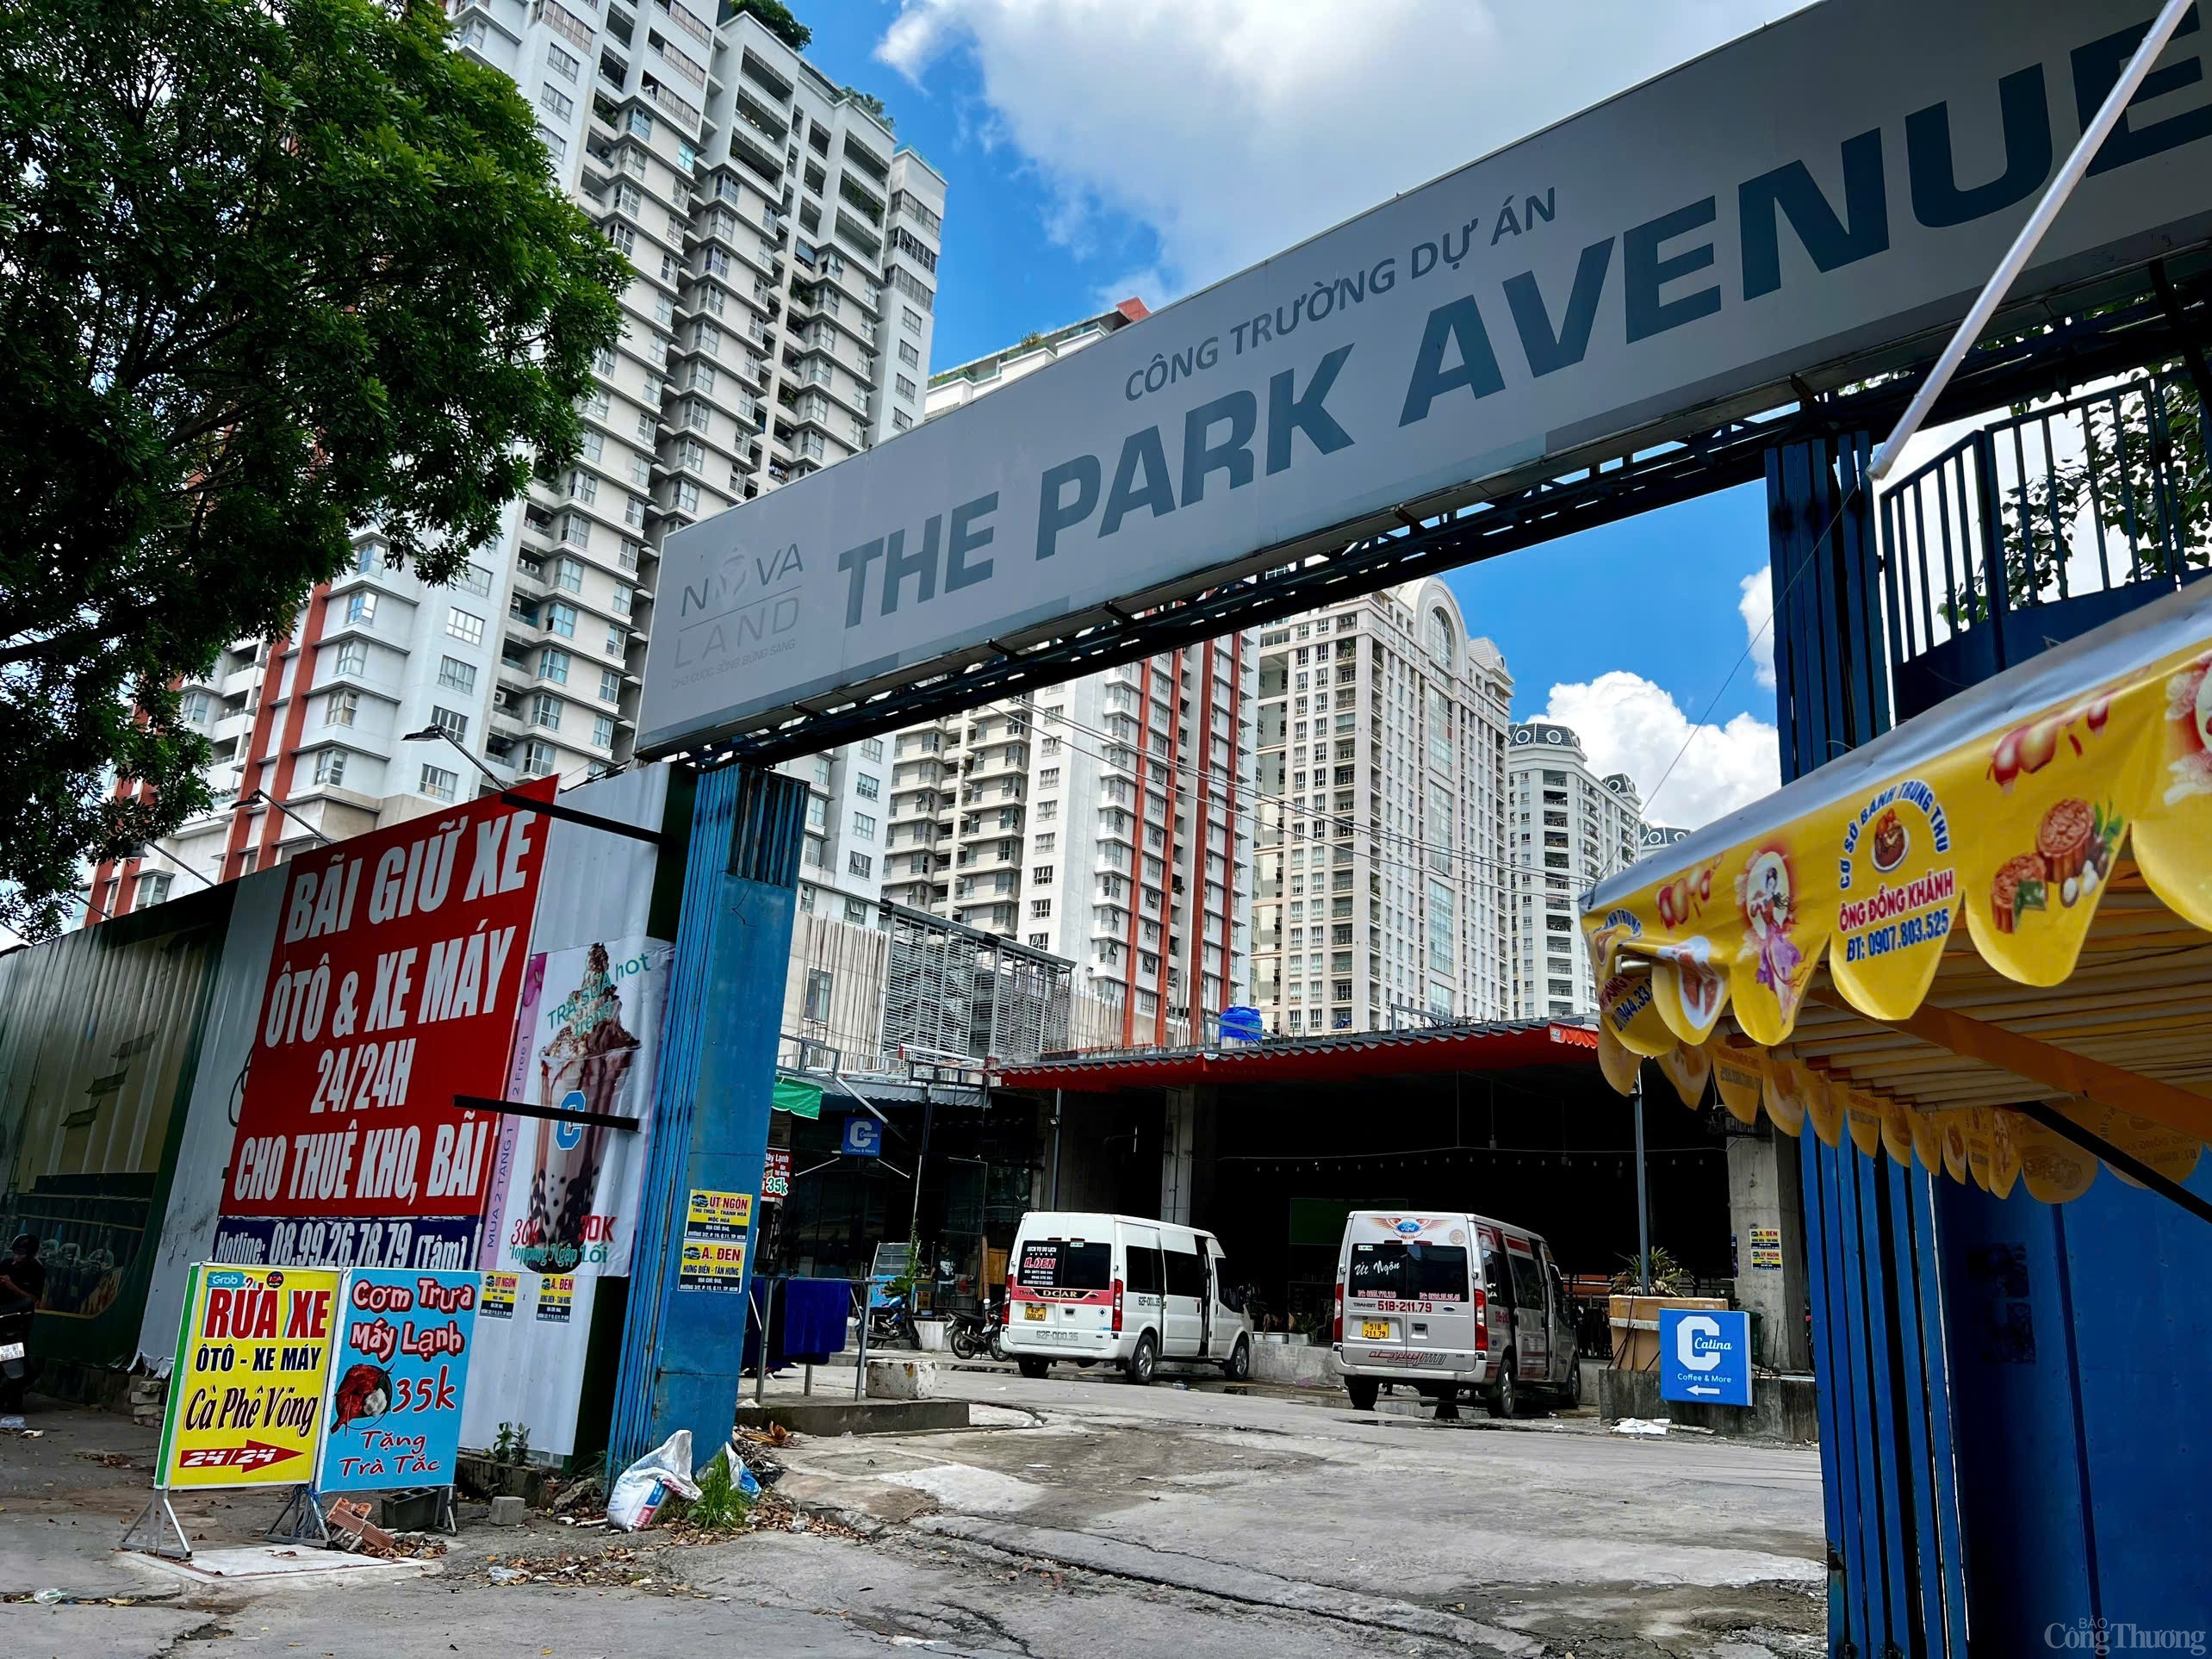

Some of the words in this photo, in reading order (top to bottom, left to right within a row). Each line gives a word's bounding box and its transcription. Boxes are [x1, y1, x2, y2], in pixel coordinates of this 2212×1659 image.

[1124, 336, 1219, 401] CÔNG
[1230, 259, 1396, 357] TRƯỜNG
[1410, 218, 1478, 279] DỰ
[1491, 186, 1556, 246] ÁN
[838, 491, 999, 629] THE
[1036, 342, 1356, 561] PARK
[1398, 3, 2212, 427] AVENUE
[674, 596, 800, 669] LAND
[1898, 780, 1934, 813] TRUNG
[1929, 805, 1949, 854] THU
[283, 849, 362, 945] BÃI
[369, 817, 464, 924] GIỮ
[463, 810, 536, 903] XE
[1839, 902, 1867, 933] ÔNG
[1907, 869, 1954, 910] KHÁNH
[1846, 935, 1865, 963] ĐT:
[1867, 908, 1949, 957] 0907.803.525
[615, 953, 651, 983] hot
[264, 952, 331, 1049] ÔTÔ
[332, 970, 359, 1036] &
[363, 947, 418, 1033] XE
[418, 919, 518, 1025] MÁY
[309, 1037, 417, 1115] 24/24H
[514, 1047, 528, 1082] Free
[850, 1121, 873, 1147] C
[234, 1135, 288, 1202] CHO
[294, 1120, 357, 1201] THUÊ
[361, 1125, 421, 1207] KHO,
[426, 1110, 488, 1198] BÃI
[493, 1192, 502, 1203] 2
[766, 1177, 788, 1196] 35k
[723, 1196, 749, 1210] NGÔN
[487, 1208, 500, 1249] MUA
[578, 1215, 618, 1244] 30K
[1401, 1223, 1415, 1232] Ford
[215, 1232, 266, 1265] Hotline:
[268, 1221, 413, 1269] 08.99.26.78.79
[413, 1234, 469, 1271] (Tâm)
[580, 1243, 608, 1264] Lối
[701, 1246, 713, 1259] A.
[716, 1247, 741, 1262] ĐEN
[212, 1275, 239, 1284] Grab
[1354, 1261, 1370, 1276] Út
[1372, 1259, 1401, 1276] Ngôn
[351, 1280, 413, 1313] Cơm
[418, 1277, 476, 1314] Trưa
[550, 1277, 557, 1289] A.
[1042, 1289, 1078, 1298] DCAR
[203, 1277, 278, 1339] RỬA
[285, 1289, 332, 1339] XE
[1378, 1301, 1432, 1314] 51B-211.79
[349, 1318, 399, 1364] Máy
[400, 1320, 466, 1362] Lạnh
[1036, 1330, 1079, 1342] 62F-000.35
[1676, 1315, 1721, 1371] C
[1693, 1336, 1733, 1351] Catina
[196, 1344, 235, 1372] ÔTÔ
[252, 1348, 276, 1371] XE
[279, 1343, 323, 1371] MÁY
[391, 1364, 457, 1414] 35k
[1677, 1373, 1703, 1382] Coffee
[1711, 1375, 1732, 1383] More
[185, 1384, 212, 1432] Cà
[217, 1386, 261, 1431] Phê
[260, 1384, 319, 1437] Võng
[183, 1447, 277, 1467] 24/24
[360, 1430, 427, 1455] Tặng
[339, 1457, 385, 1478] Trà
[393, 1455, 441, 1474] Tắc
